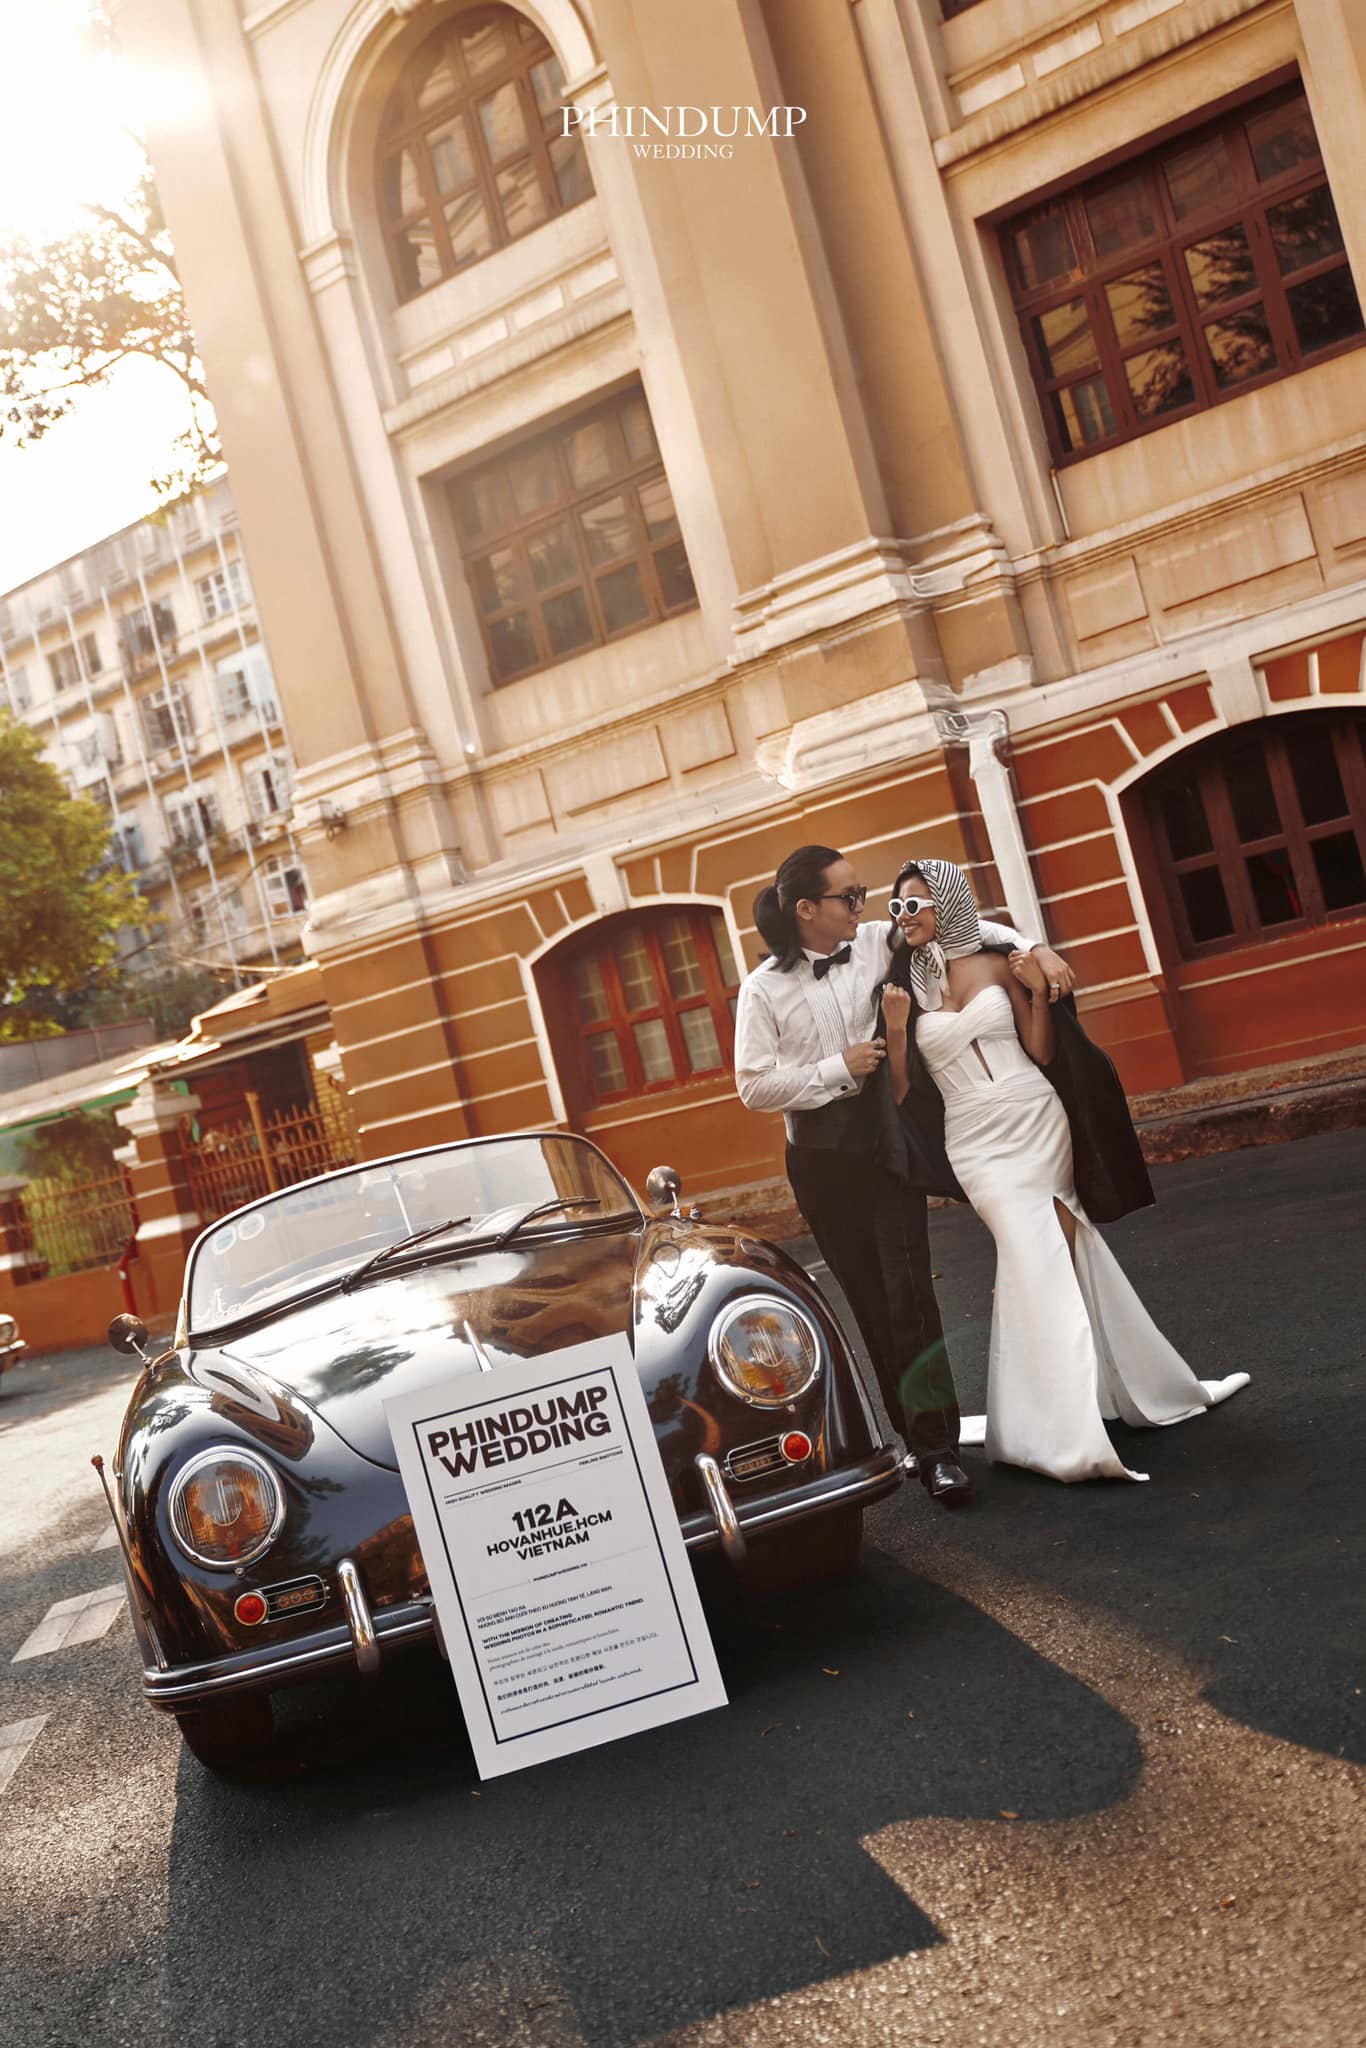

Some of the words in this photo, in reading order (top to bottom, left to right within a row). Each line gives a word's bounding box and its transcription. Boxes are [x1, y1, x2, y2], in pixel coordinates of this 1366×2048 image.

[427, 1385, 607, 1457] PHINDUMP
[438, 1411, 611, 1478] WEDDING
[511, 1497, 579, 1532] 112A
[486, 1509, 612, 1556] HOVANHUE.HCM
[516, 1530, 589, 1560] VIETNAM
[511, 1630, 535, 1641] PHOTOS
[543, 1612, 572, 1625] CREATING
